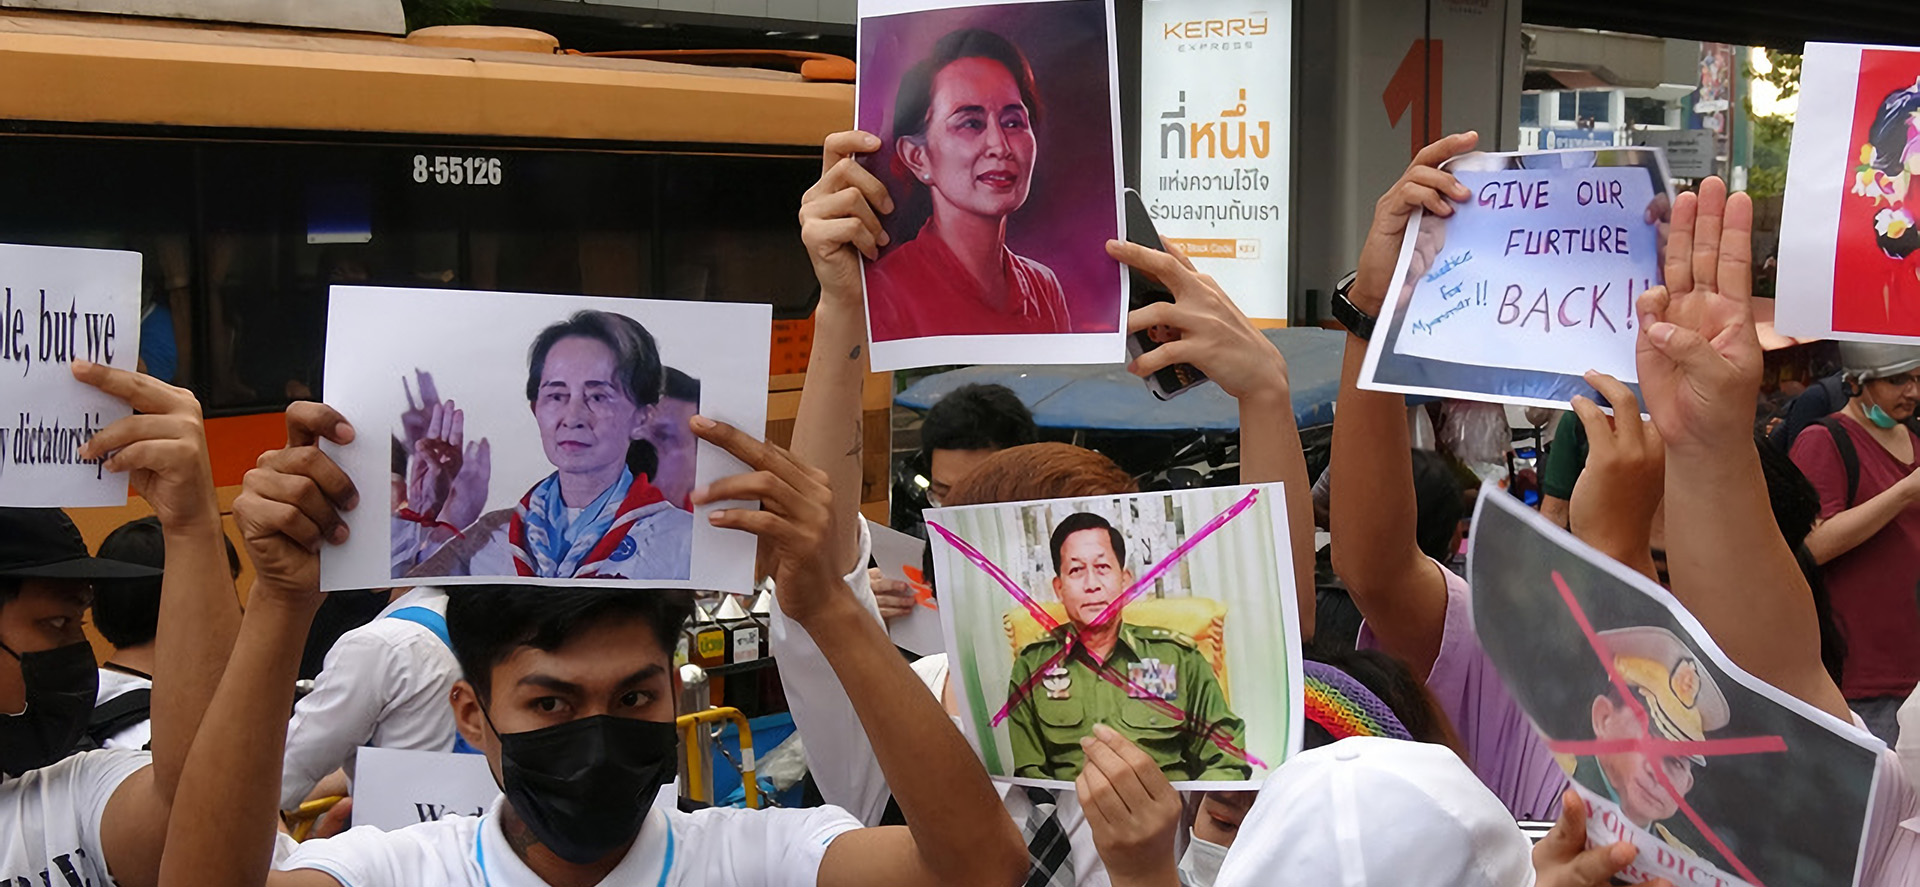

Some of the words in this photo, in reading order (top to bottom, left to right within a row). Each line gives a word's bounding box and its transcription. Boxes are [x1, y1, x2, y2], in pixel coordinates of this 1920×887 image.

[1164, 17, 1267, 39] KERRY
[1177, 41, 1253, 53] EXPRESS
[1160, 88, 1270, 159] ที่หนึ่ง
[1159, 168, 1269, 191] แห่งความไว้ใจ
[1478, 180, 1549, 210] GIVE
[1577, 180, 1624, 209] OUR
[1505, 225, 1629, 257] FURTURE
[39, 289, 78, 364] but
[85, 311, 116, 365] we
